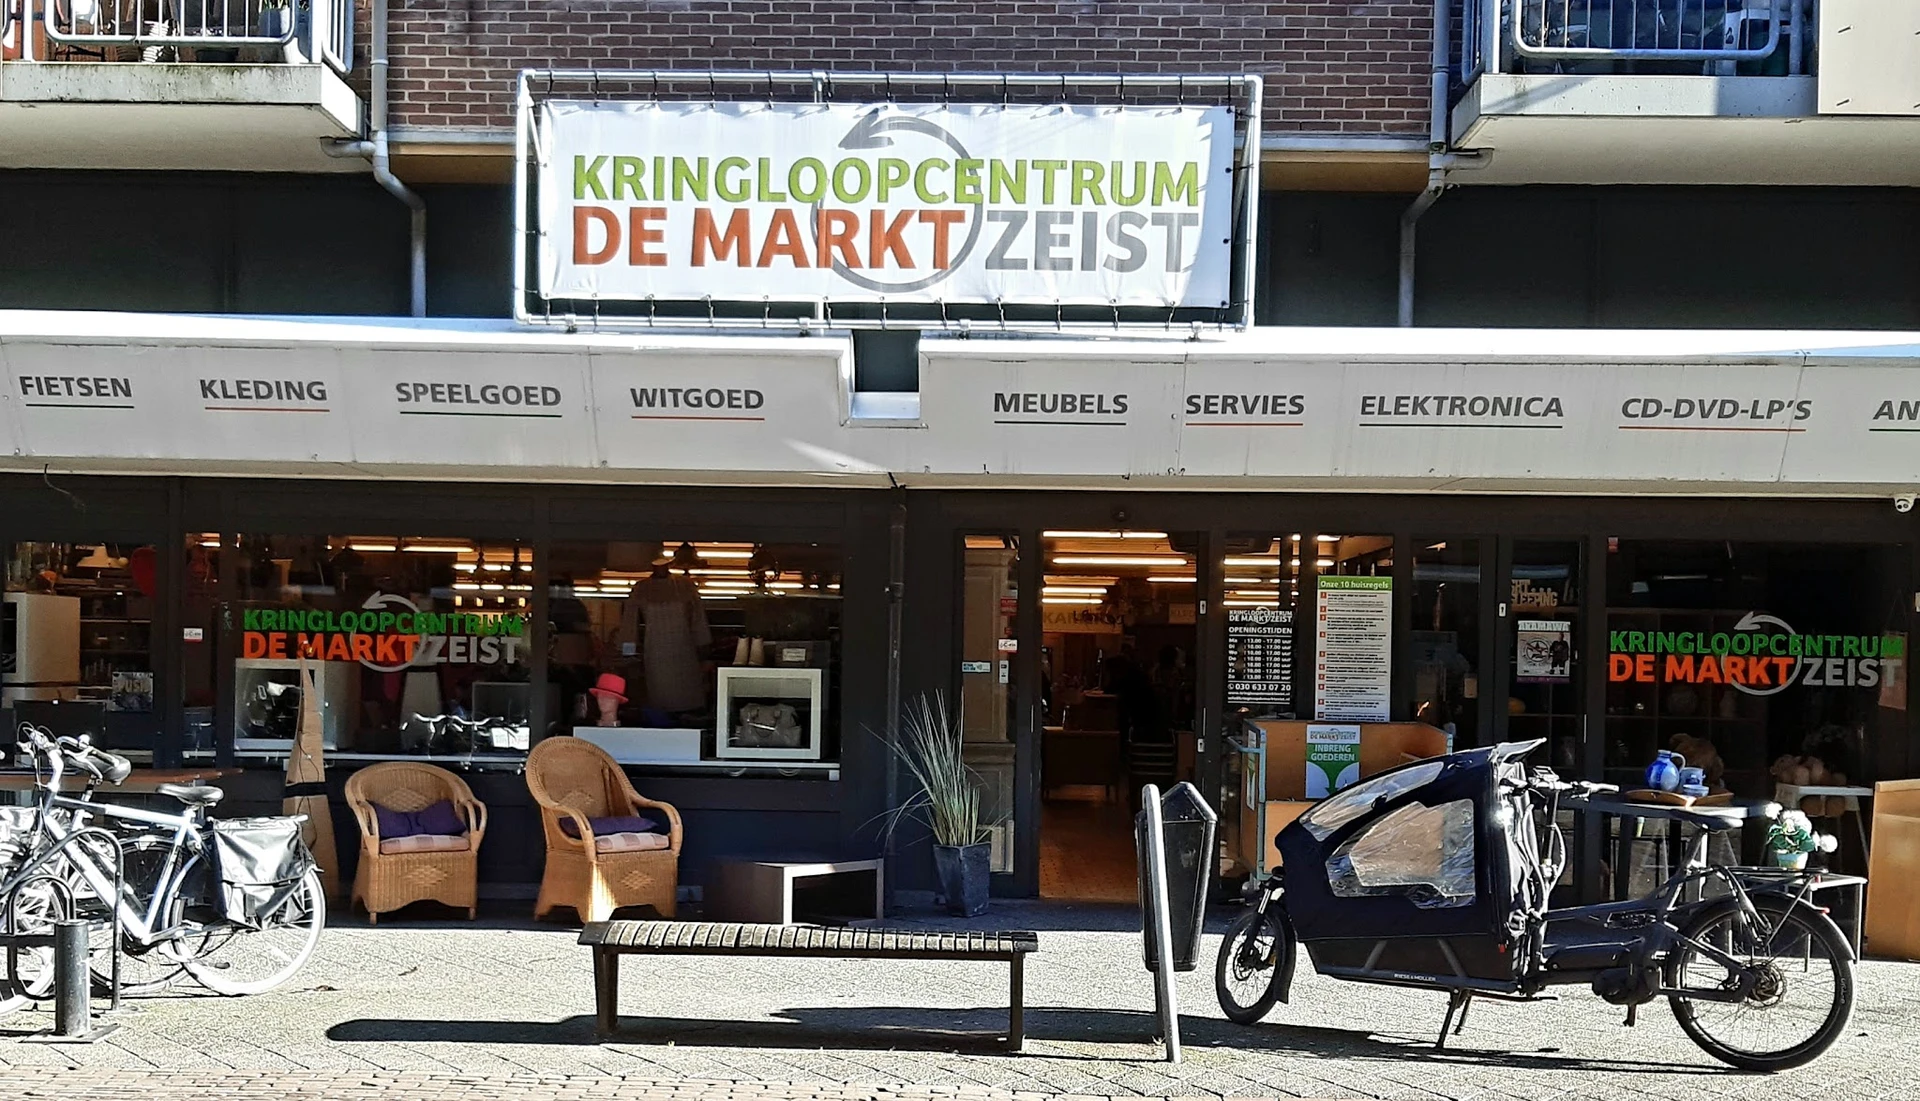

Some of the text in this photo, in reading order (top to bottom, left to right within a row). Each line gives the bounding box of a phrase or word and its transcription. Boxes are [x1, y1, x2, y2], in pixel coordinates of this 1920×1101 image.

[572, 154, 1199, 206] KRINGLOOPCENTRUM
[572, 206, 1199, 273] DE MARKT ZEIST
[19, 375, 132, 398] FIETSEN
[199, 379, 328, 402] KLEDING
[395, 381, 562, 407] SPEELGOED
[630, 387, 765, 410] WITGOED
[994, 392, 1128, 415] MEUBELS
[1185, 393, 1305, 416] SERVIES
[1360, 395, 1564, 419] ELEKTRONICA
[1620, 397, 1812, 422] CD-DVD-LP'S
[1320, 580, 1339, 588] Onze
[1350, 581, 1389, 590] huisregels
[244, 609, 524, 636] KRINGLOOPCENTRUM
[1228, 626, 1293, 634] OPENINGSTIJDEN
[243, 632, 522, 664] DE MARKT ZEIST
[1609, 631, 1905, 658] KRINGLOOPCENTRUM
[1609, 654, 1903, 687] DE MARKT ZEIST
[1251, 683, 1267, 691] 633
[1310, 753, 1355, 761] GOEDEREN
[1314, 744, 1352, 753] INBRENG
